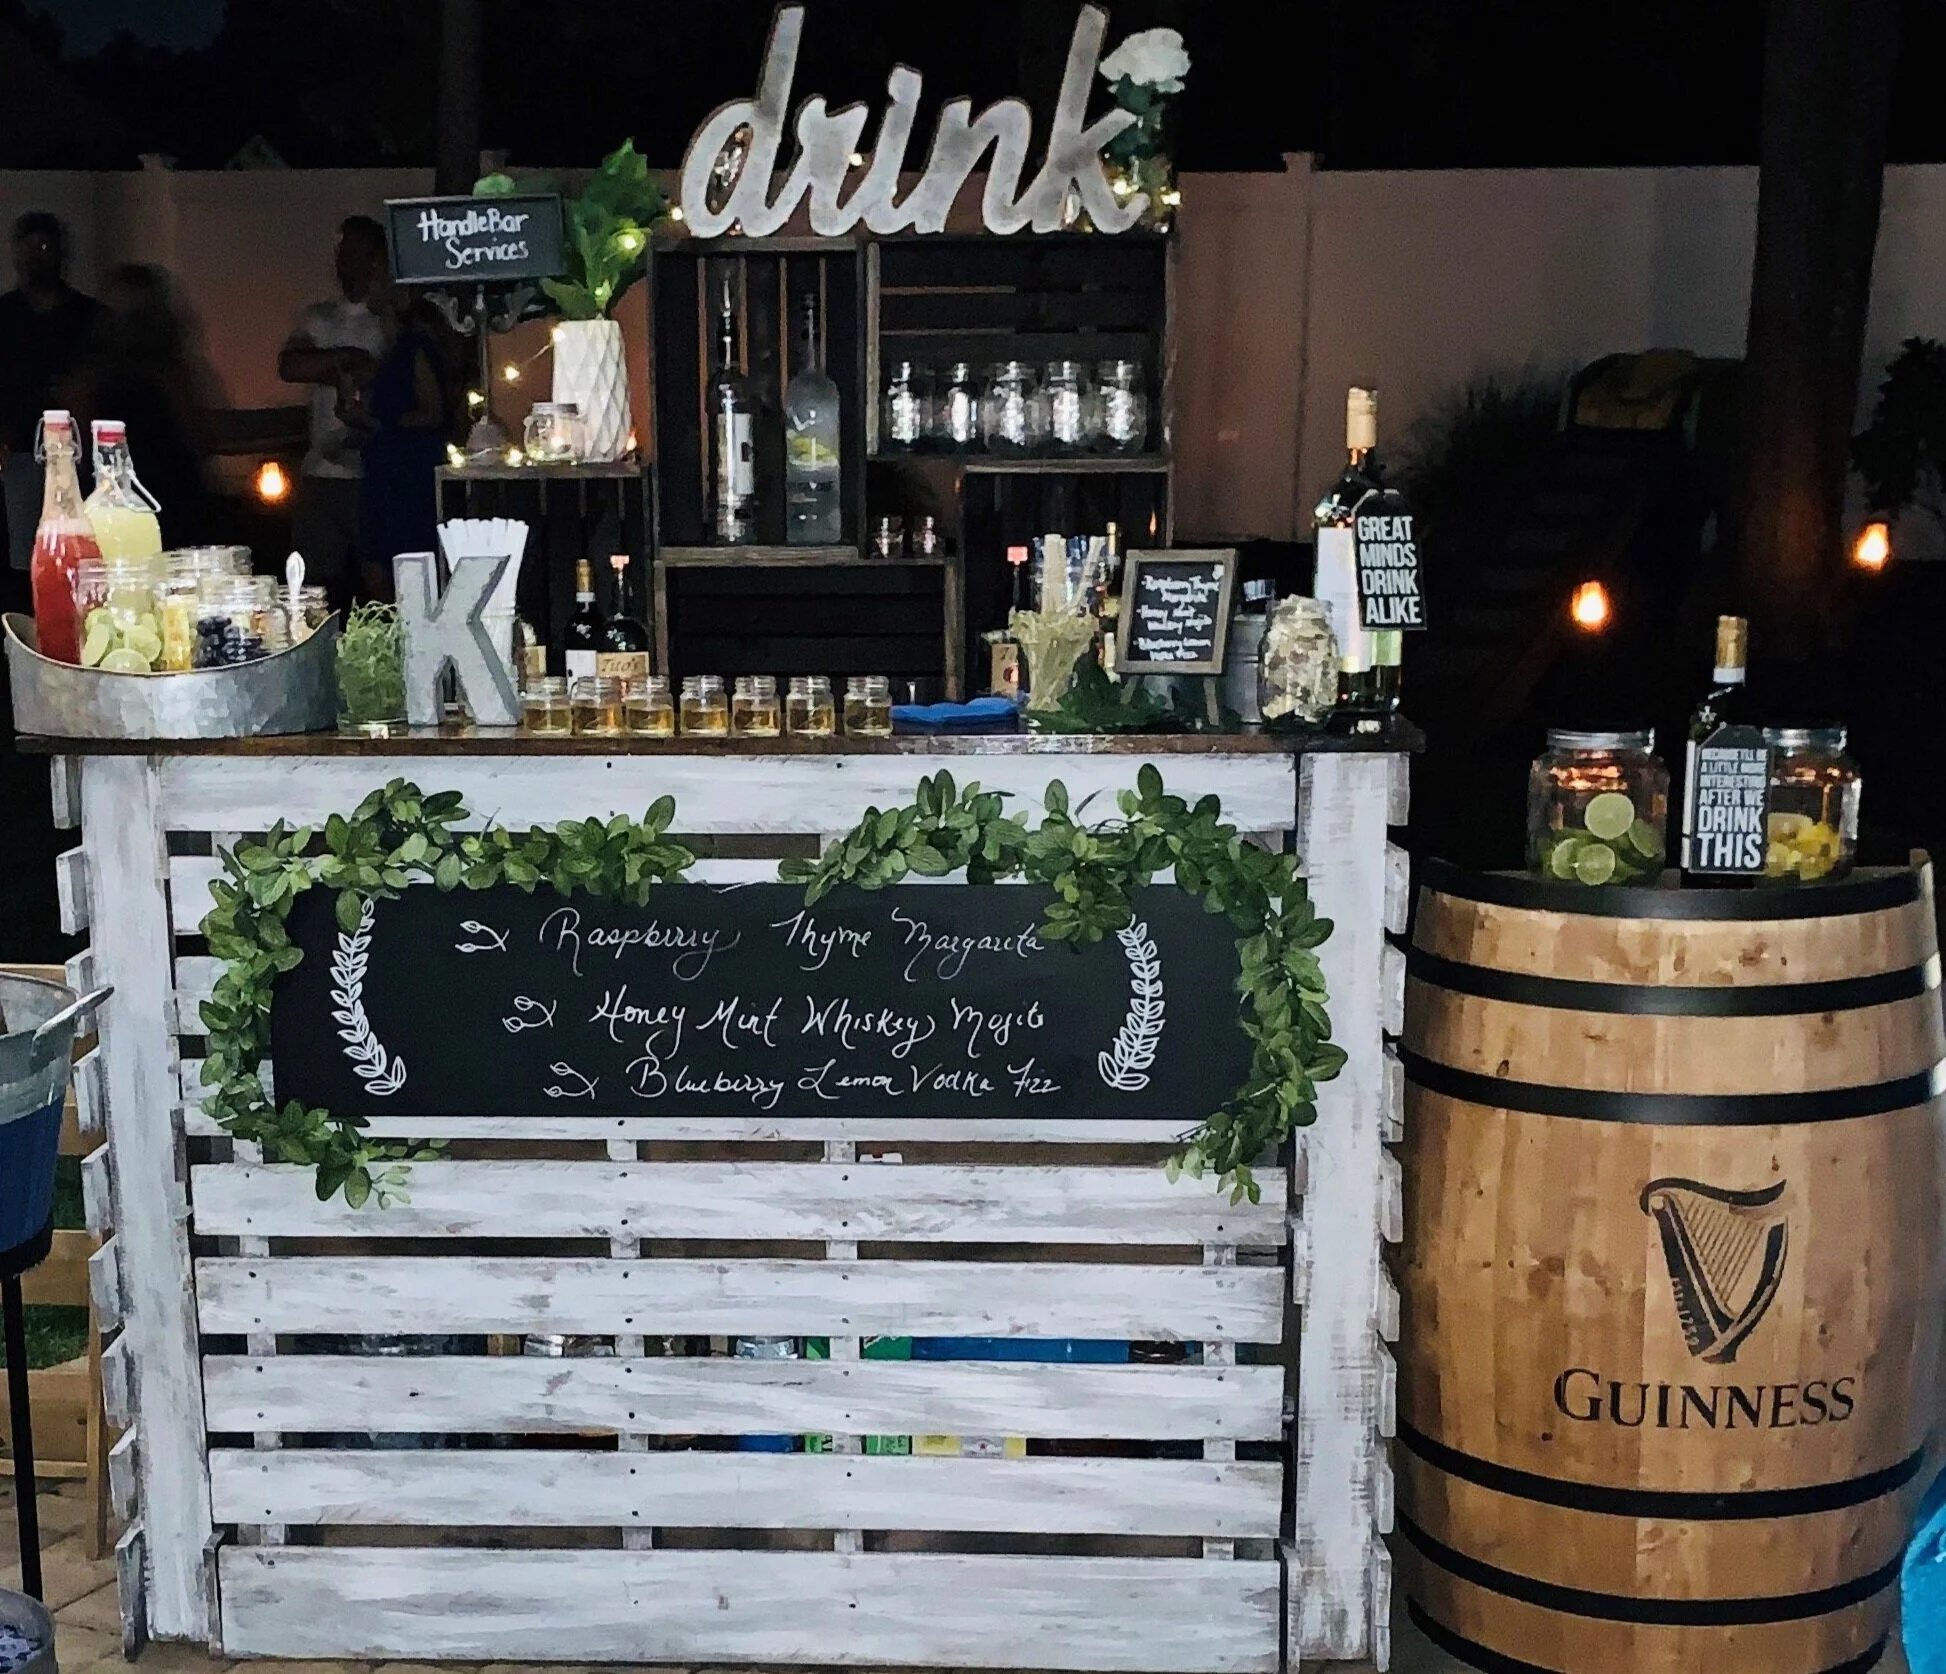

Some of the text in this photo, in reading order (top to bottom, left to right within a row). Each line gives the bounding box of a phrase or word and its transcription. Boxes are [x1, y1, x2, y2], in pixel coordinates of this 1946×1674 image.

[681, 2, 1150, 238] drink
[417, 208, 529, 242] HandleBar
[445, 236, 528, 269] Services
[1358, 516, 1413, 541] GREAT
[1360, 543, 1417, 567] MINDS
[1361, 569, 1419, 595] DRINK
[1366, 596, 1422, 624] ALIKE
[393, 552, 519, 726] K
[1699, 789, 1765, 806] AFTER WE
[1698, 806, 1763, 832] DRINK
[1697, 833, 1763, 868] THIS
[769, 910, 871, 971] Thyme
[891, 907, 1045, 982] Margarita
[589, 984, 1045, 1059] Honey Mint Whiskey Mojito
[798, 1059, 905, 1100] Lemon
[910, 1063, 995, 1097] Vodka
[1007, 1058, 1062, 1098] Fizz
[1554, 1368, 1856, 1429] GUINNESS
